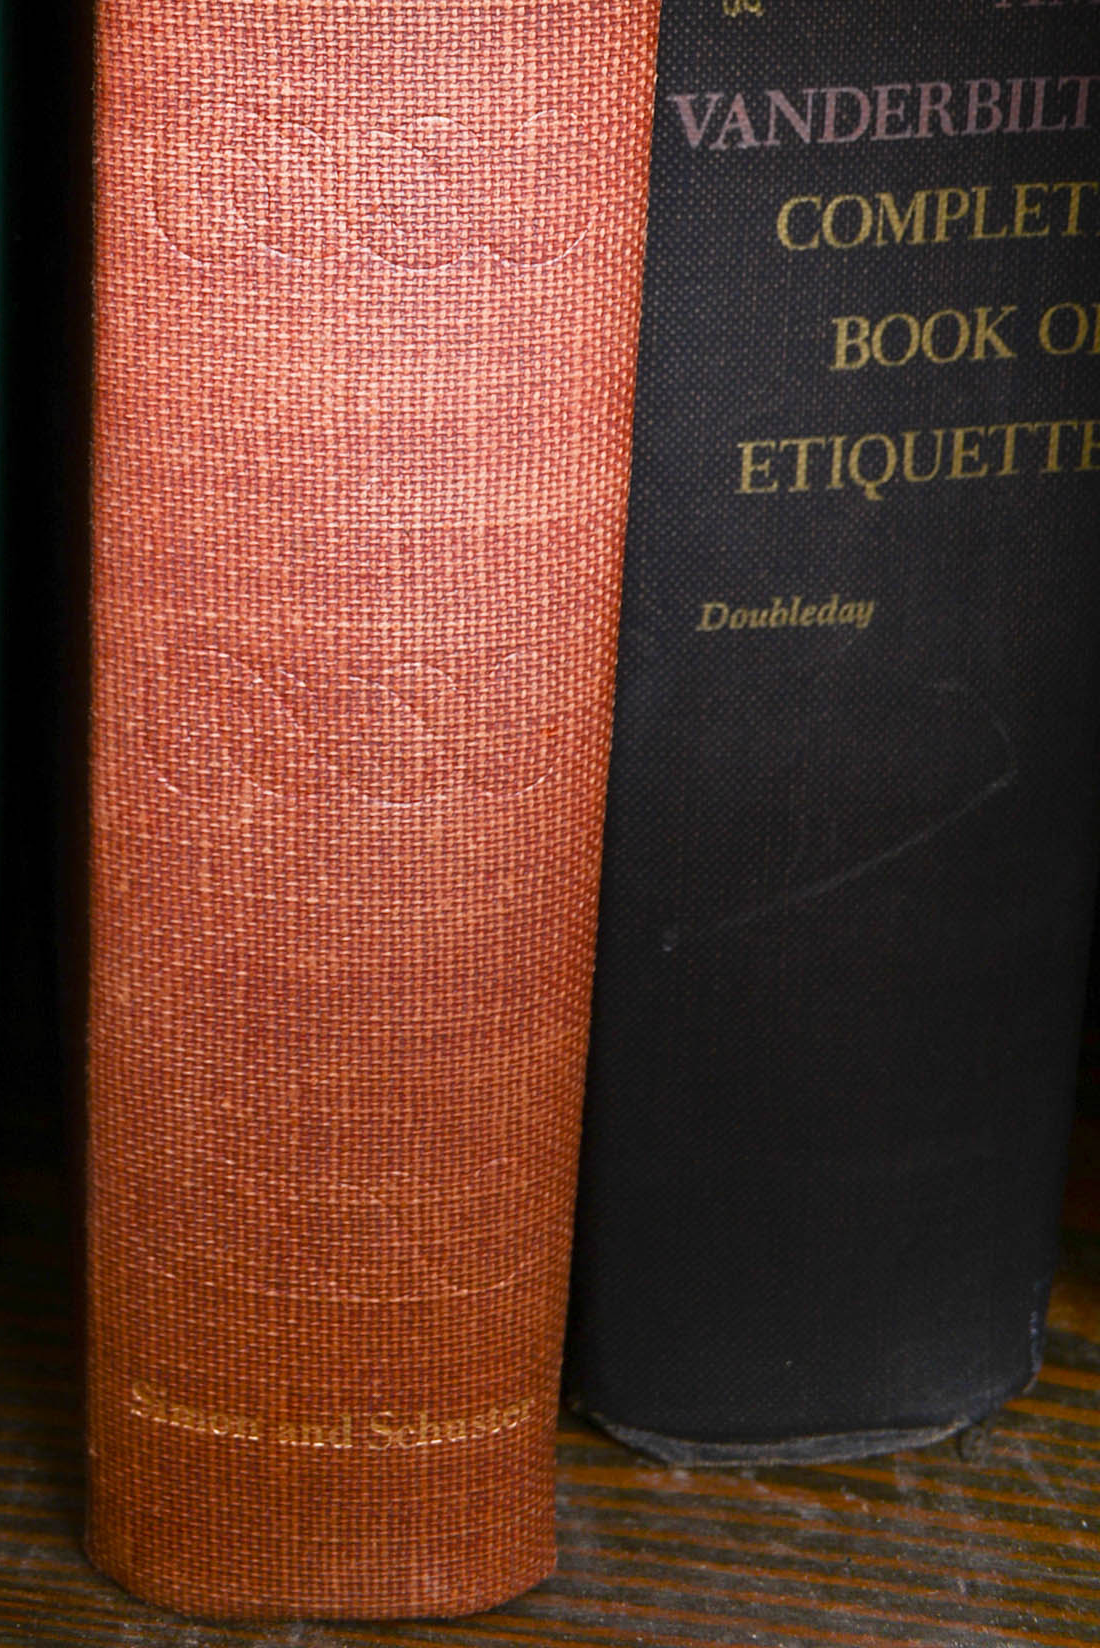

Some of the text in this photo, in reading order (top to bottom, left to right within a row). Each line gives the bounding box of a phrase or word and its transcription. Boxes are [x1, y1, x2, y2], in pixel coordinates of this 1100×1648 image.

[666, 74, 1100, 151] VANDERBILT
[776, 181, 1100, 252] COMPLET
[829, 305, 1017, 371] BOOK
[696, 596, 876, 633] Doubleday
[129, 1380, 536, 1451] Simon and Schuster
